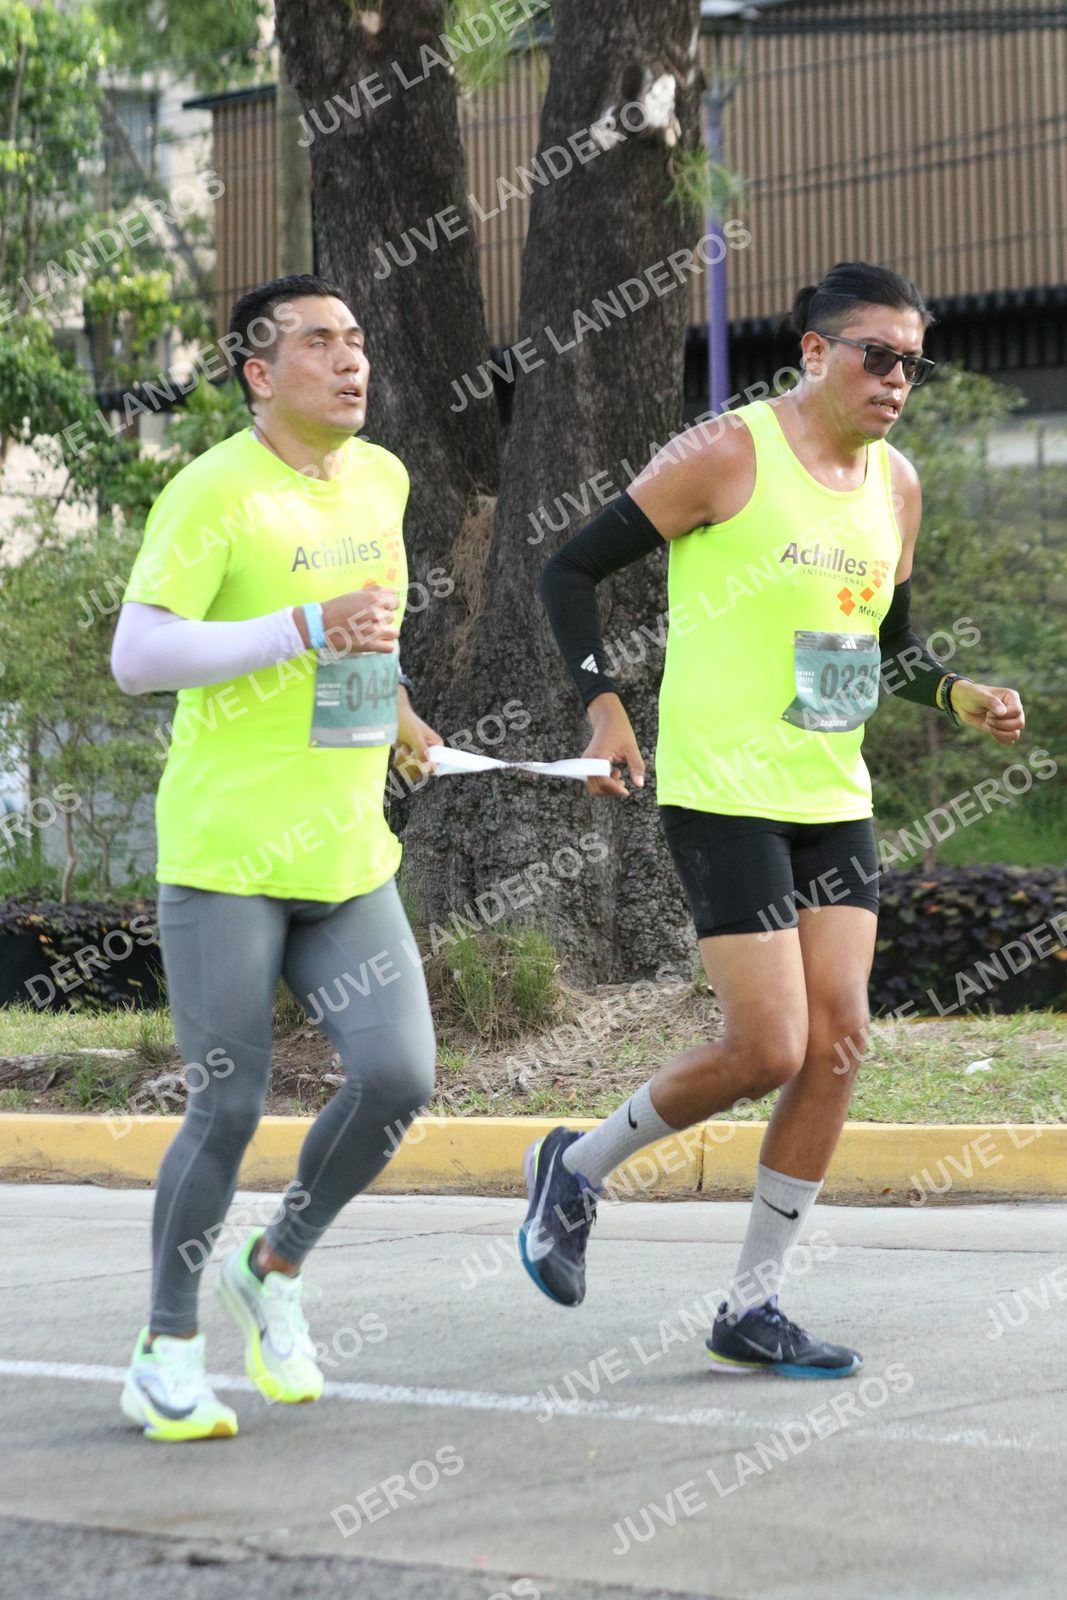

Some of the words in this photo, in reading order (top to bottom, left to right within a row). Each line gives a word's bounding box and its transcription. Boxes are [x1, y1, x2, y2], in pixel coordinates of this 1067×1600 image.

[290, 537, 382, 572] Achilles
[779, 542, 868, 577] Achilles
[803, 569, 864, 587] INTERNATIONAL
[346, 670, 398, 712] 044
